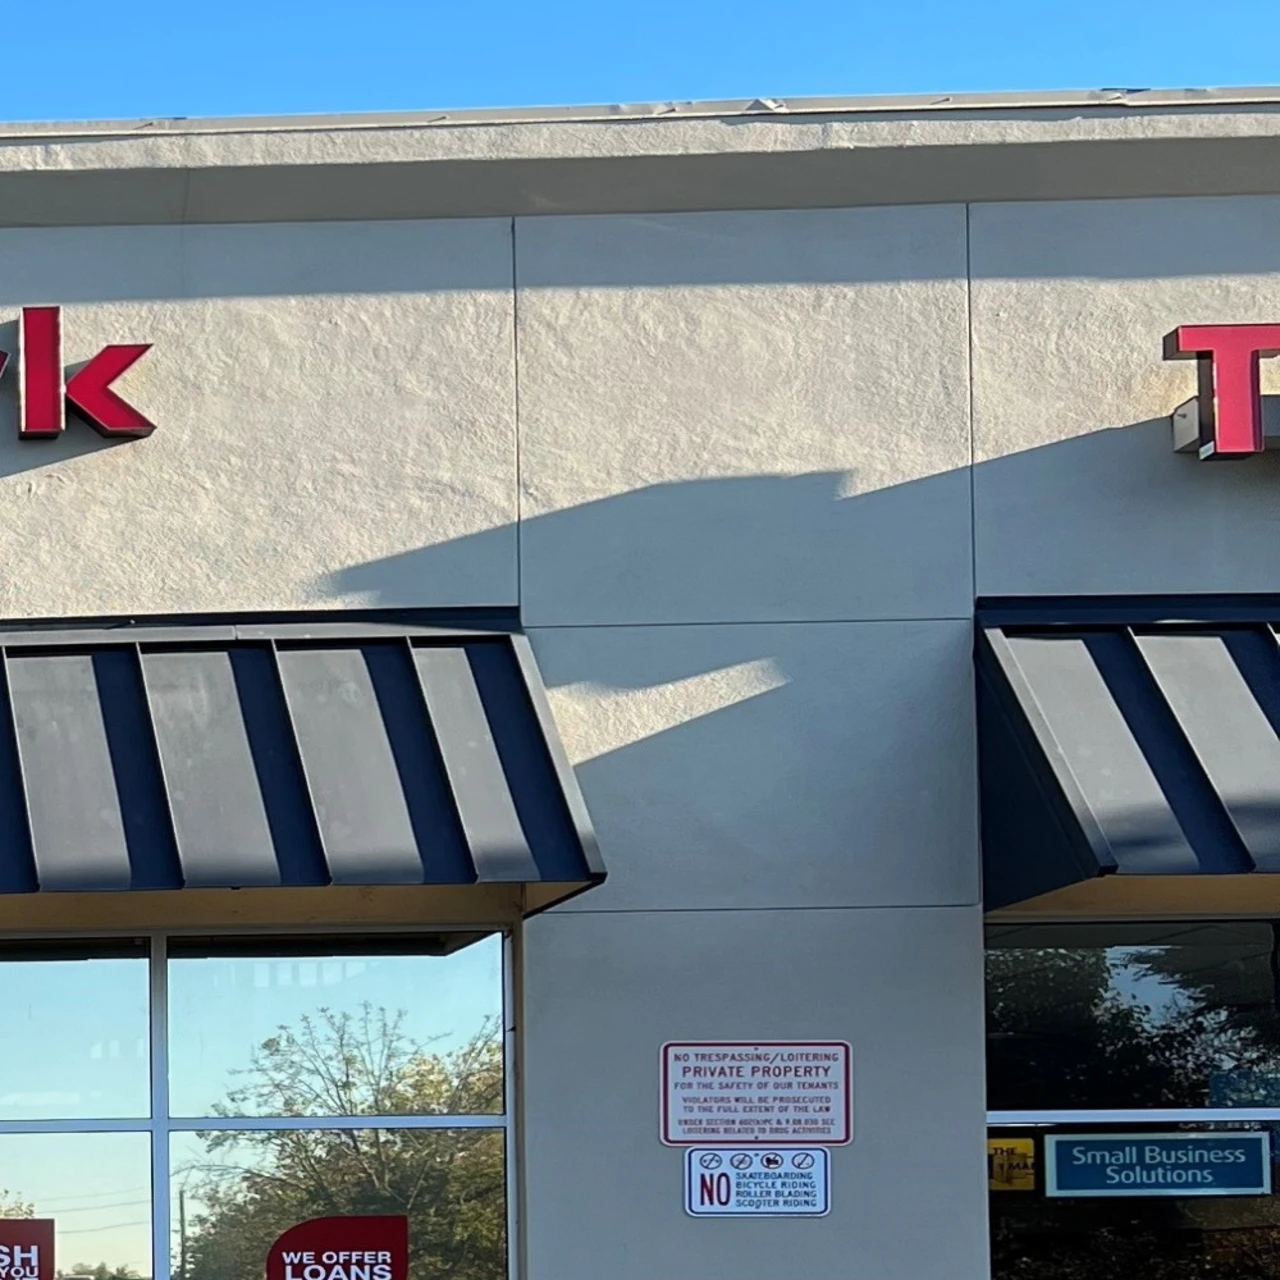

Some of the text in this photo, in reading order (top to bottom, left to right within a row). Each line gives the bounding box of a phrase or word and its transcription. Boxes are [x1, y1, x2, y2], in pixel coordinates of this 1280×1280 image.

[674, 1053, 690, 1062] NO
[682, 1066, 831, 1078] PRIVATE PROPERTY
[674, 1081, 839, 1090] FOR THE SAFETY OF OUR TENANTS
[682, 1096, 831, 1104] VIOLATORS WILL BE PROSECUTED
[683, 1105, 830, 1113] TO THE FULL EXTENT OF THE LAW
[1072, 1144, 1246, 1165] Small Business
[735, 1172, 813, 1180] SKATEBOARDING
[1106, 1165, 1213, 1184] Solutions
[700, 1172, 731, 1206] NO
[735, 1181, 816, 1189] BICYCLE RIDING
[735, 1190, 817, 1198] ROLLER BLADING
[735, 1199, 817, 1207] SCOOTER RIDING
[282, 1251, 392, 1264] WE OFFER
